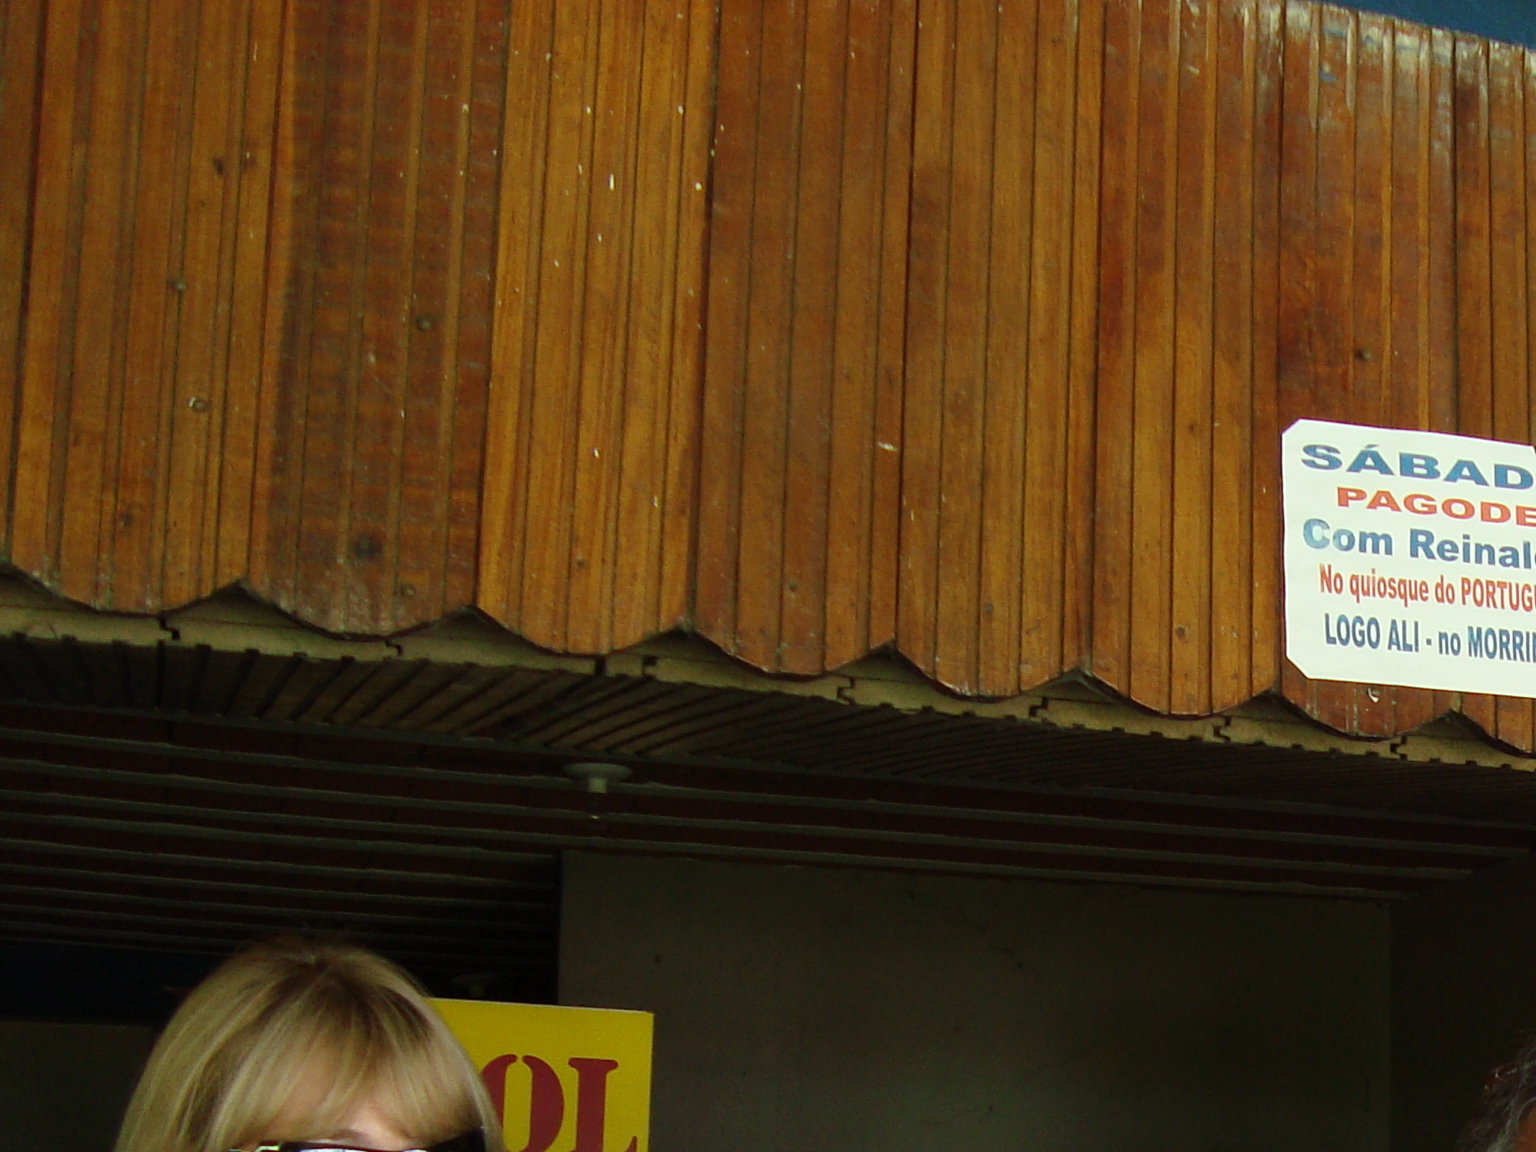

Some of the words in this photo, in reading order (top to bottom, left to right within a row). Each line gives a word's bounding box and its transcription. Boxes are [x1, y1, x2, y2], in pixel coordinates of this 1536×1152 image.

[1303, 518, 1393, 555] Com
[1319, 563, 1344, 594] No
[1350, 569, 1429, 608] quiosque
[1434, 575, 1455, 604] do
[1324, 613, 1381, 649] LOGO
[1387, 619, 1419, 652] ALI
[1438, 631, 1461, 656] no
